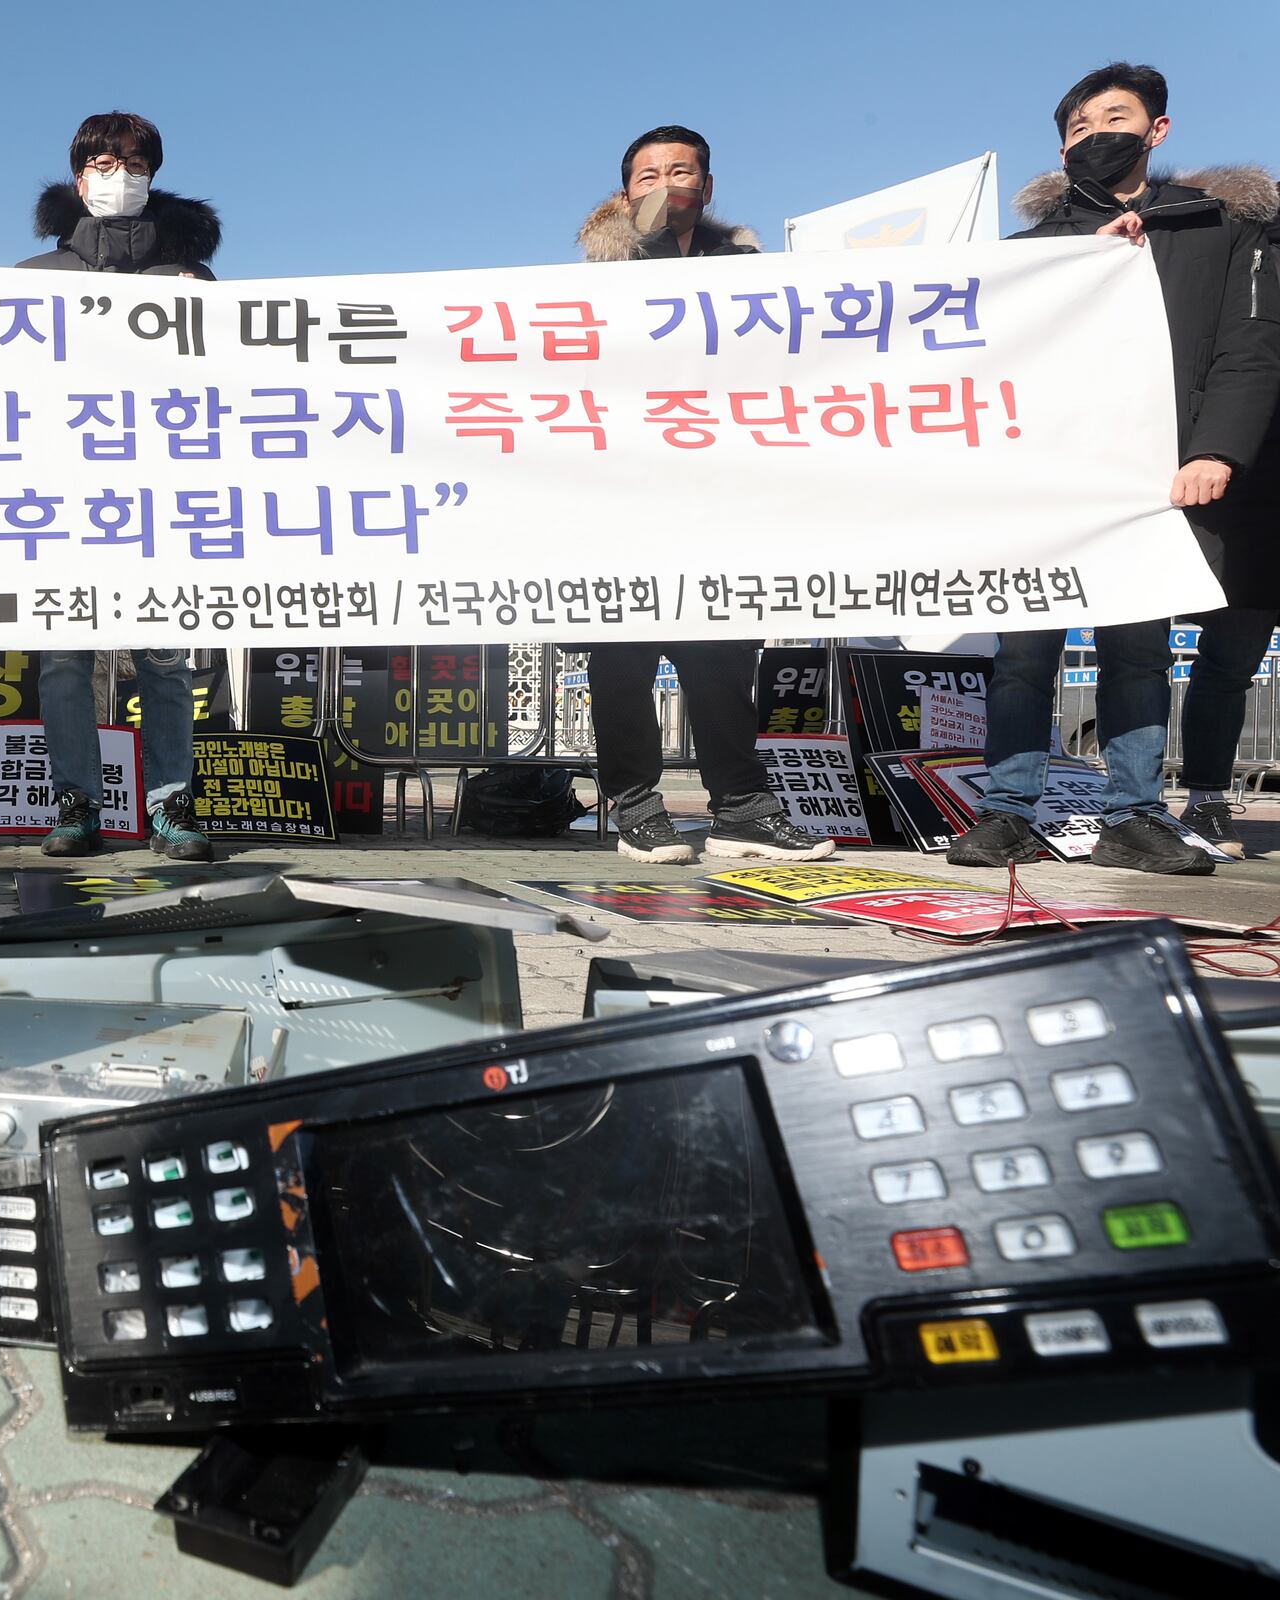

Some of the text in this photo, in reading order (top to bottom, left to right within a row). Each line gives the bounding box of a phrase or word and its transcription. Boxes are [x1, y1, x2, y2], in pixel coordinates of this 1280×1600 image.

[238, 298, 408, 365] 따른
[444, 300, 608, 363] 긴급
[646, 278, 986, 357] 기자회견
[68, 387, 406, 460] 집합금지
[443, 388, 609, 454] 즉각
[643, 376, 1022, 449] 중단하라!
[32, 585, 99, 631] 주최
[136, 579, 378, 632] 소상공인연합회
[417, 573, 663, 626] 전국상인연합회
[699, 563, 1089, 622] 한국코인노래연습장협회
[903, 670, 987, 699] 우리의
[192, 741, 286, 760] 코인노래방은
[196, 758, 320, 782] 시설이 아닙니다!
[766, 772, 834, 793] 합금지
[202, 778, 282, 798] 전 국민의
[194, 798, 313, 820] 활공간입니다!
[505, 1059, 529, 1085] TJ
